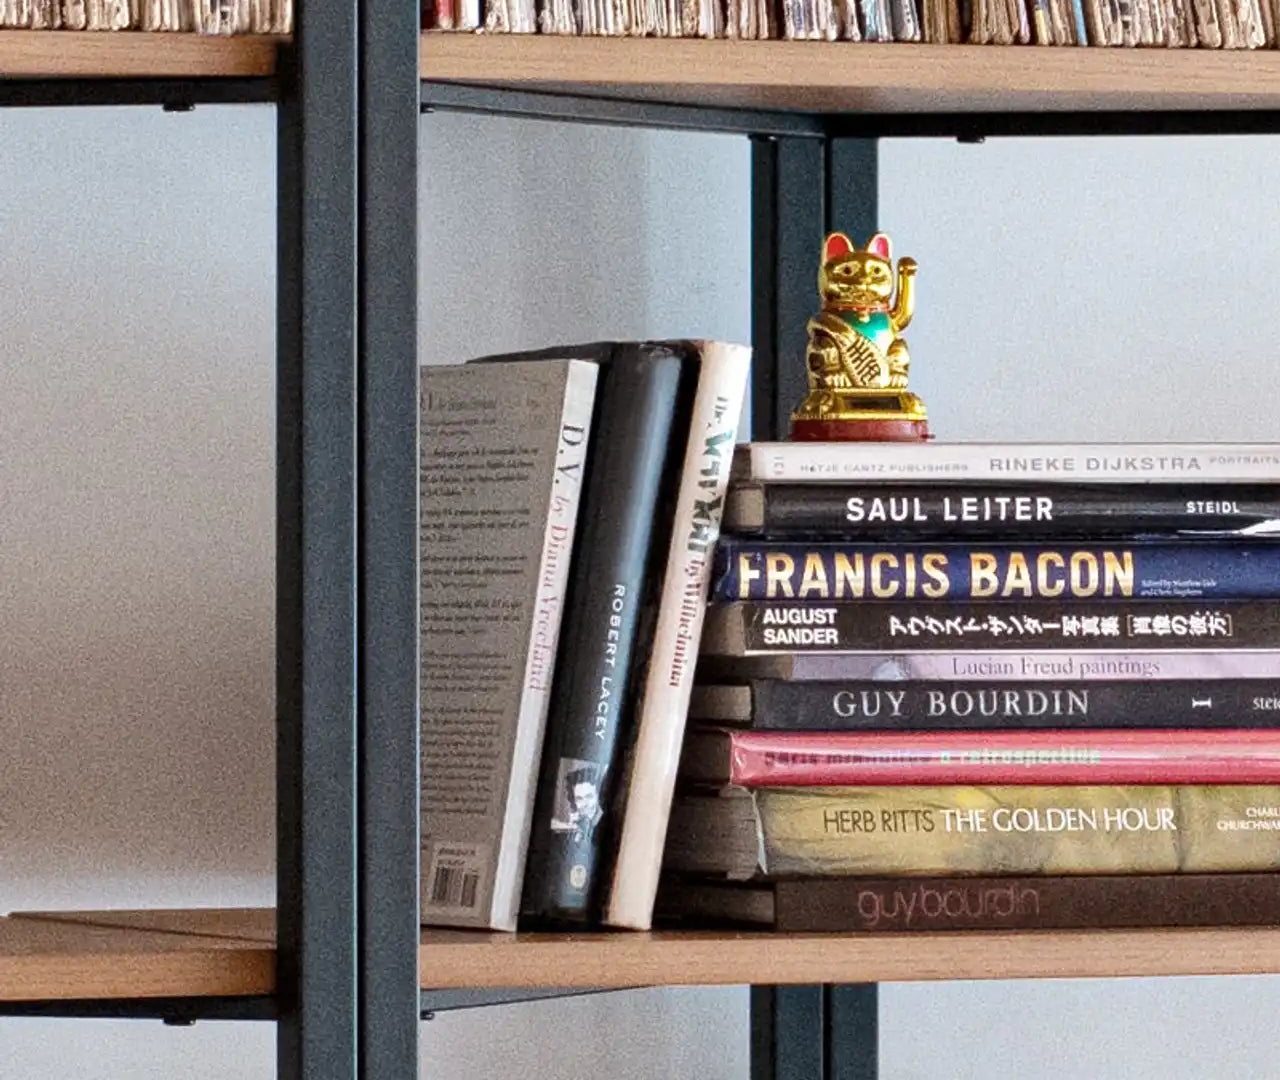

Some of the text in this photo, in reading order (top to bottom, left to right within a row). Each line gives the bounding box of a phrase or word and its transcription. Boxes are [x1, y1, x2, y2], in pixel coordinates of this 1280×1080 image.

[989, 457, 1075, 471] RINEKE
[1086, 457, 1202, 471] DIJKSTRA
[846, 497, 1054, 521] SAUL LEITER
[1186, 501, 1241, 514] STEIDL
[738, 551, 1135, 598] FRANCIS BACON
[763, 609, 837, 625] AUGUST
[528, 592, 559, 694] Vreeland
[763, 629, 839, 644] SANDER
[593, 583, 626, 740] ROBERT LACEY
[952, 657, 1161, 676] Lucian Freud paintings
[833, 689, 1089, 717] GUY BOURDIN
[824, 807, 1177, 834] HERB RITTS THE GOLDEN HOUR
